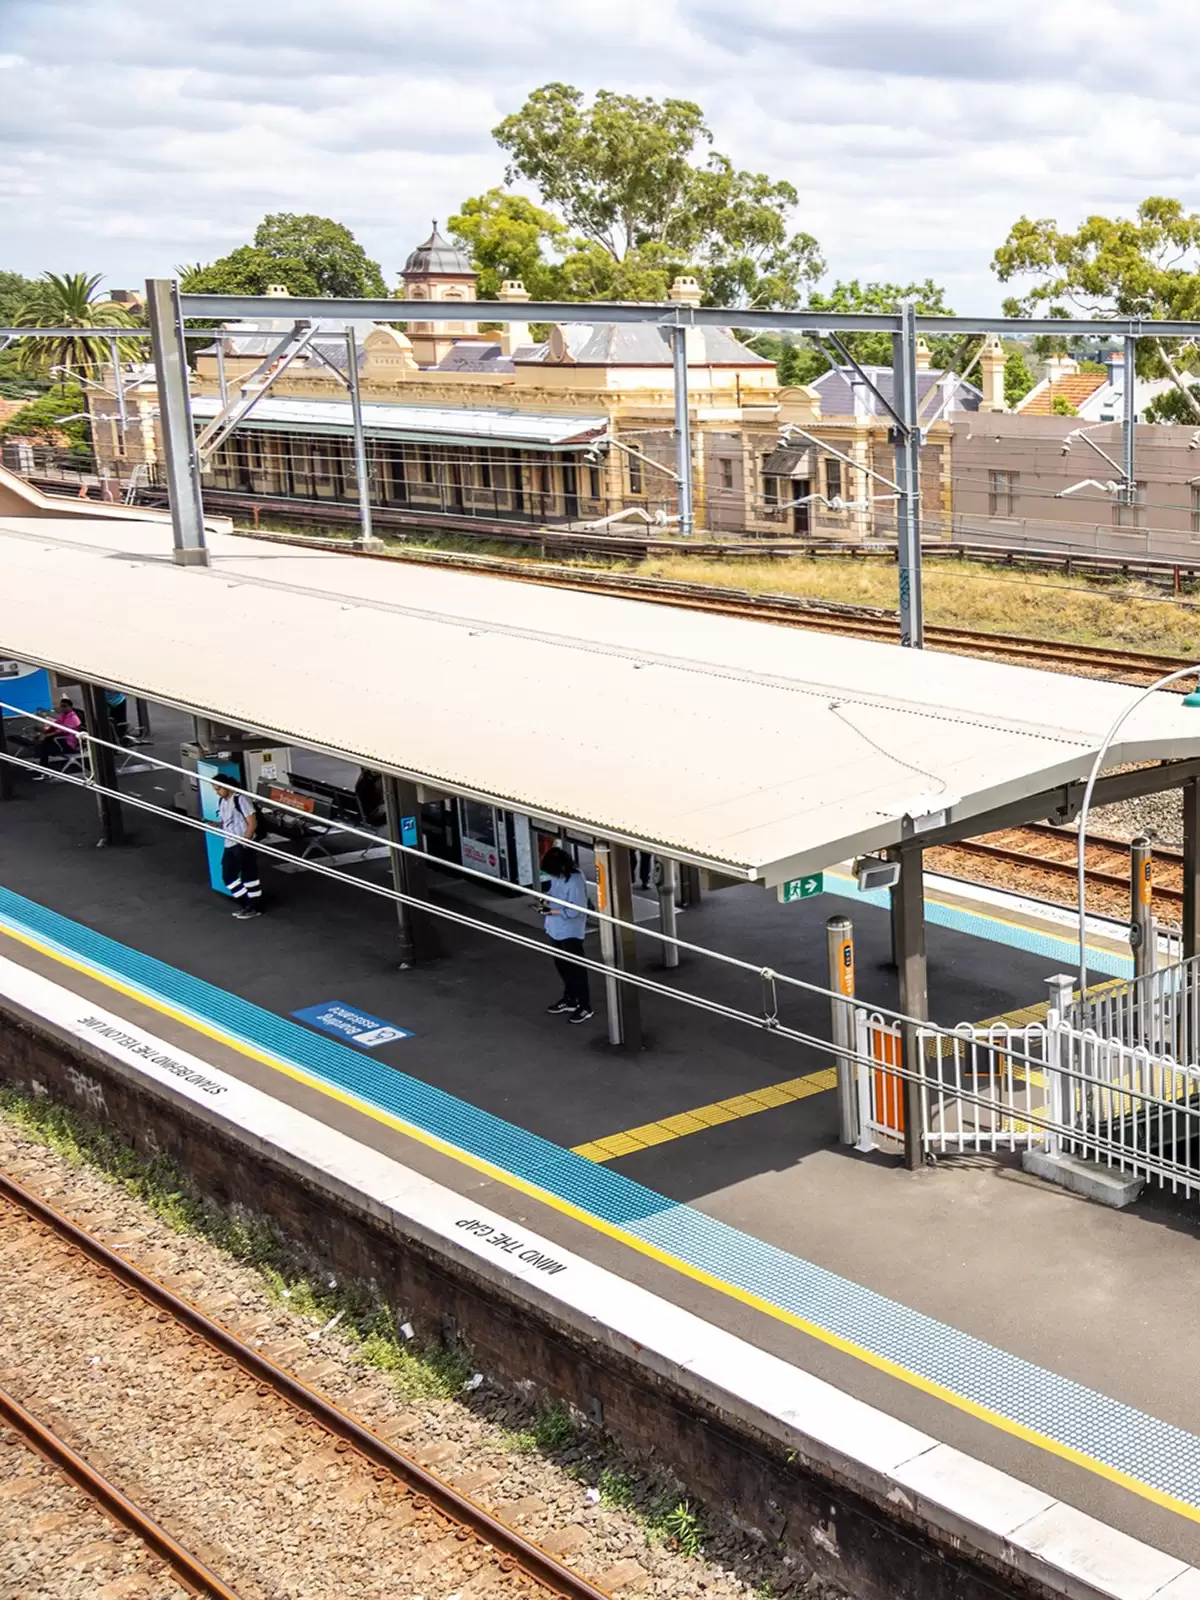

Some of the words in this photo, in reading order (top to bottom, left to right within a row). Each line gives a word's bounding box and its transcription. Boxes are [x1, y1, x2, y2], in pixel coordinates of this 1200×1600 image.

[76, 1016, 105, 1032] LINE
[102, 1029, 141, 1050] YELLOW
[131, 1045, 156, 1059] THE
[151, 1055, 193, 1077] BEHIND
[184, 1075, 228, 1095] STAND
[455, 1219, 495, 1236] GAP
[486, 1233, 524, 1254] THE
[518, 1250, 567, 1275] MIND
